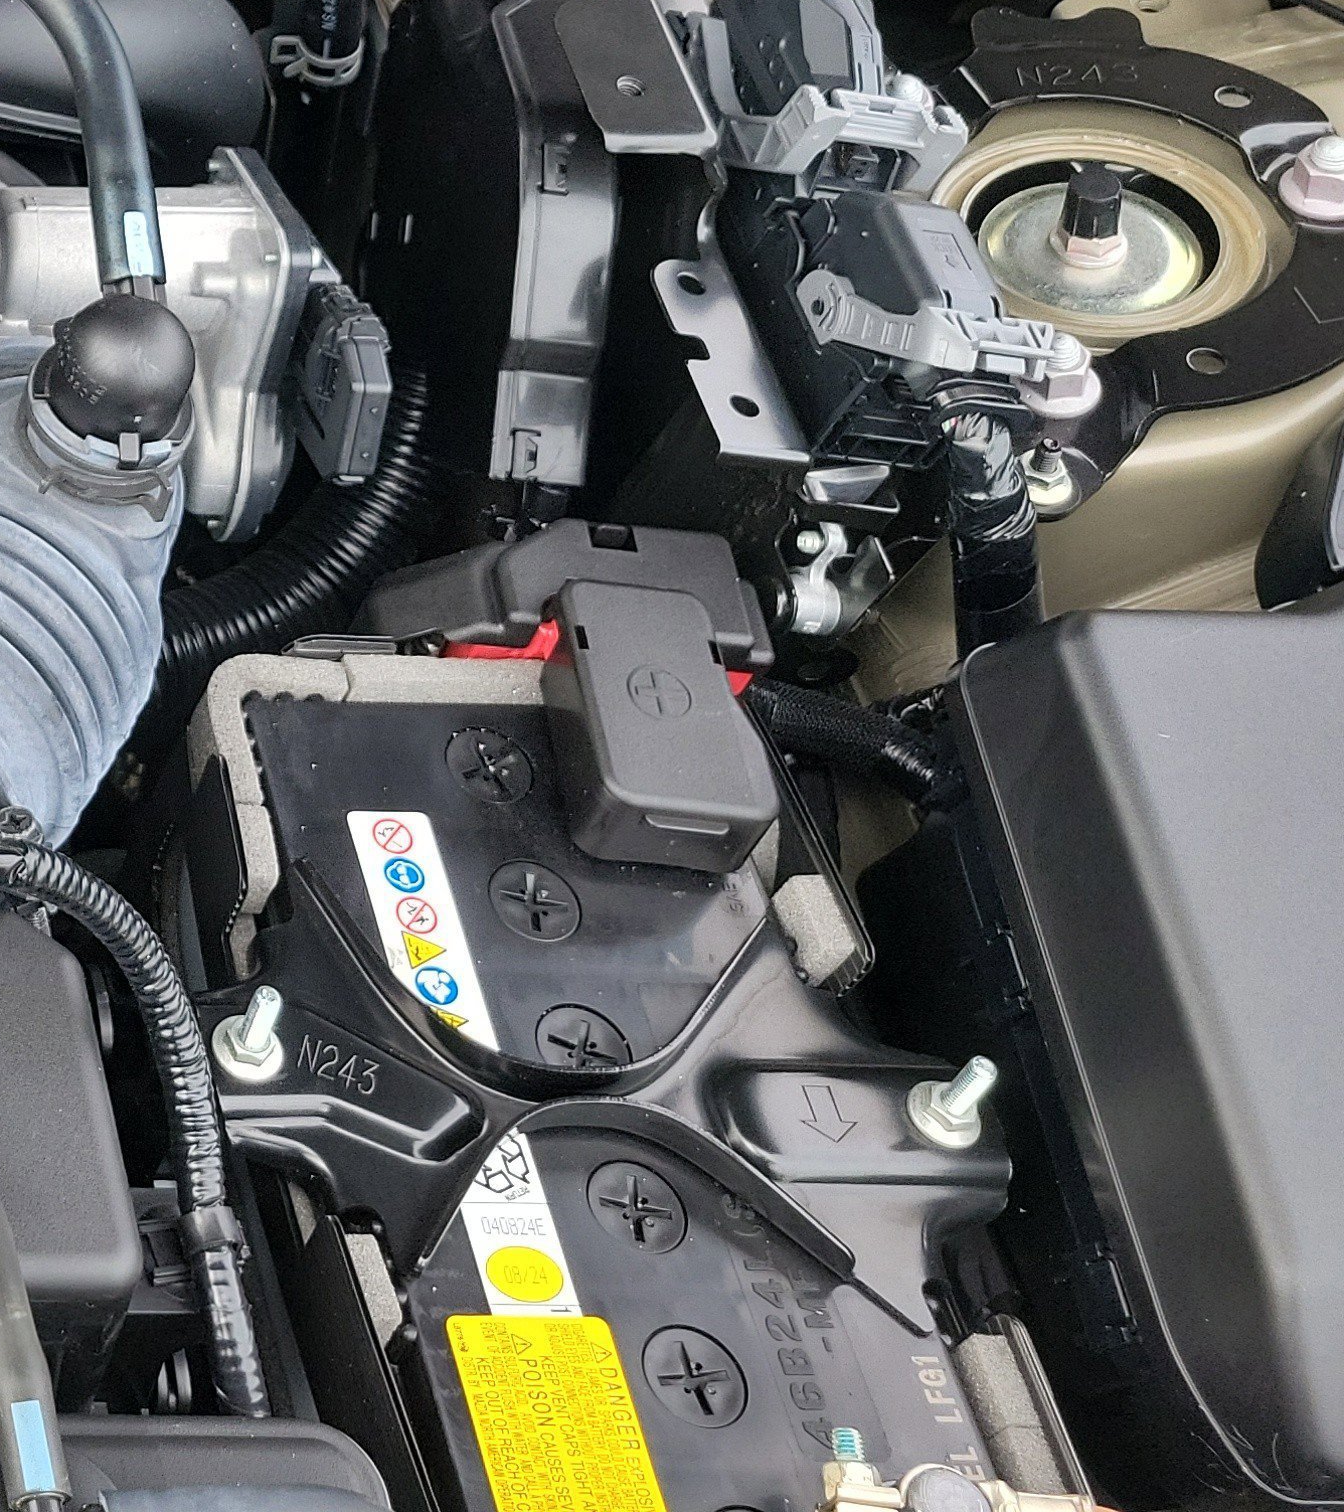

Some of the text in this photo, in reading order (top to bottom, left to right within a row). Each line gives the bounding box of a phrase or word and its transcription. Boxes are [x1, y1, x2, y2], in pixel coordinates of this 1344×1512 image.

[1016, 63, 1140, 88] N243
[294, 1032, 380, 1096] N243
[480, 1216, 547, 1236] 040824E
[474, 1357, 496, 1386] KEEP
[538, 1355, 560, 1385] KEEP
[484, 1390, 504, 1415] OUT
[548, 1389, 571, 1420] VENT
[598, 1368, 640, 1449] DANGER
[492, 1418, 509, 1434] OF
[518, 1358, 555, 1426] POISON
[538, 1432, 566, 1482] CAUSES
[559, 1424, 581, 1456] CAPS
[497, 1438, 522, 1479] REACH
[510, 1483, 528, 1499] OF
[569, 1461, 593, 1497] TIGHT
